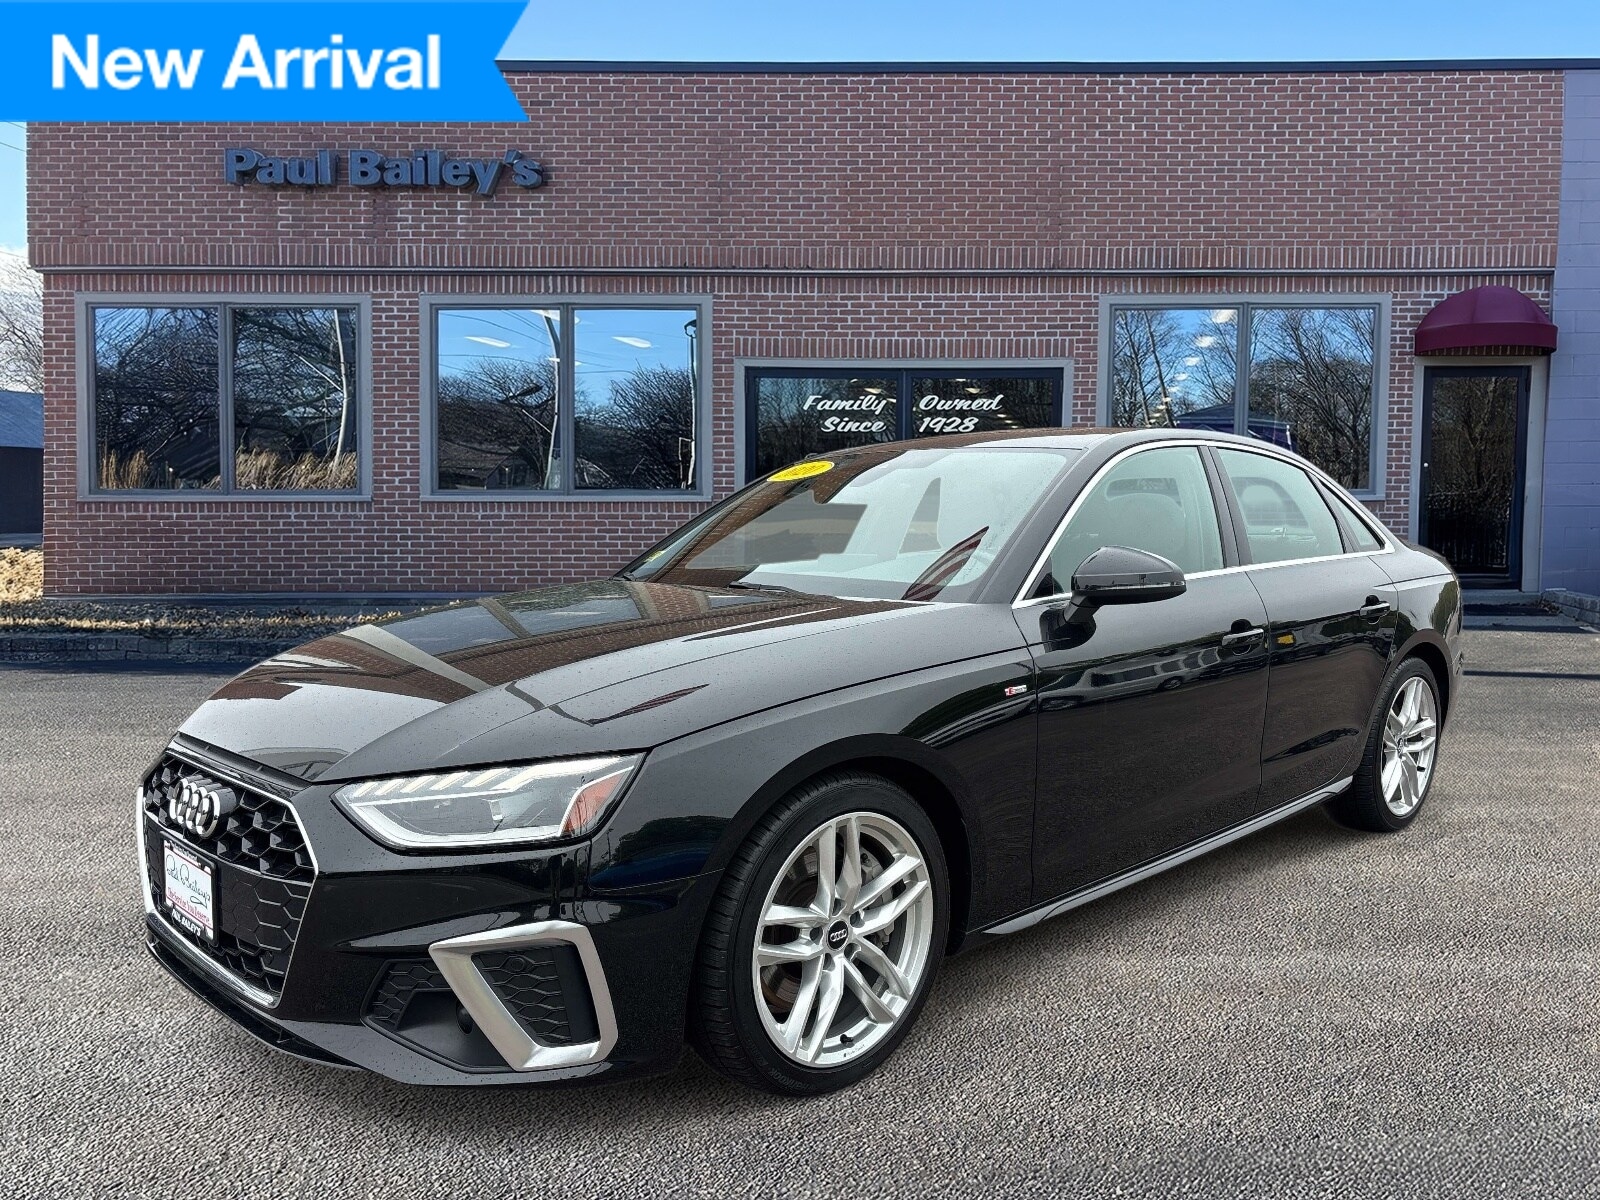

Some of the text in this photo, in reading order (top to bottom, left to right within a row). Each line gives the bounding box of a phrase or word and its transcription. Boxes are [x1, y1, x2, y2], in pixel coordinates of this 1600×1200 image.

[223, 148, 545, 197] Paul Bailey's
[802, 393, 1005, 416] Family Owned
[820, 415, 979, 433] Since 1928
